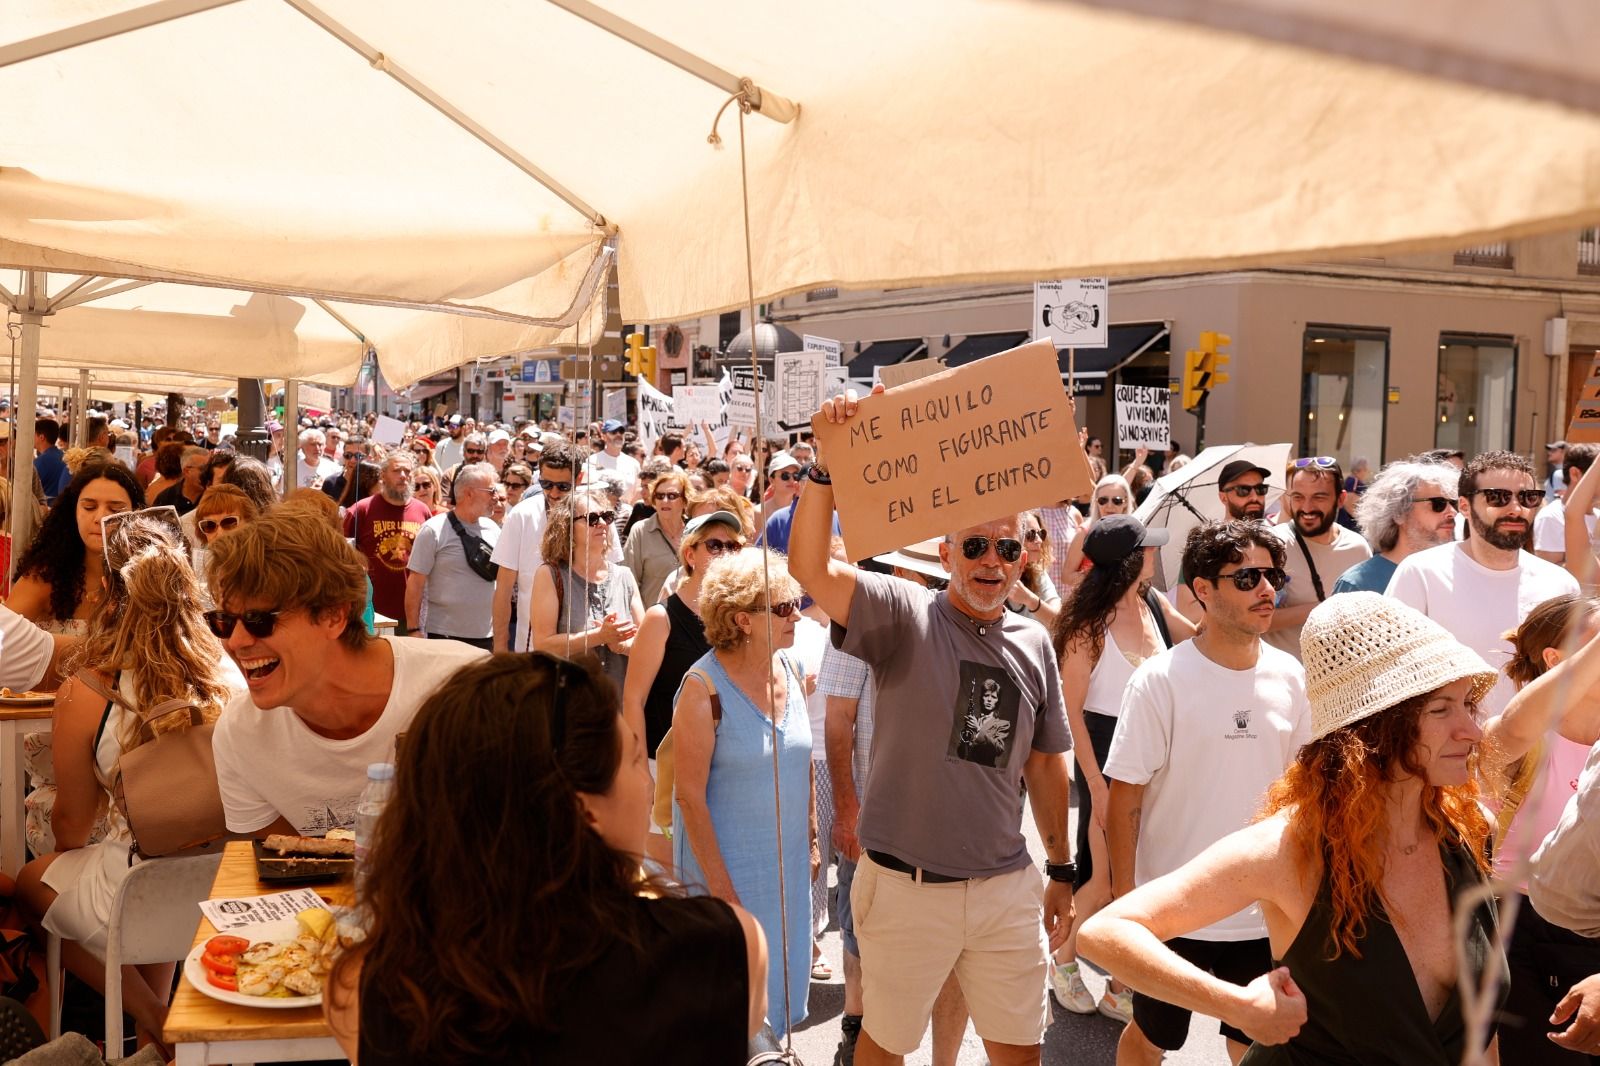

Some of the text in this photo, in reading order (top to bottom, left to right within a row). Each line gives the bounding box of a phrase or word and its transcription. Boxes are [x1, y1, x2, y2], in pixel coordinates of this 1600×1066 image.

[744, 377, 764, 390] VEE
[1125, 406, 1168, 424] VIVIENDA
[850, 384, 993, 448] ME ALQUILO
[863, 408, 1052, 485] COMO FIGURANTE
[888, 456, 1051, 523] EN EL CENTRO
